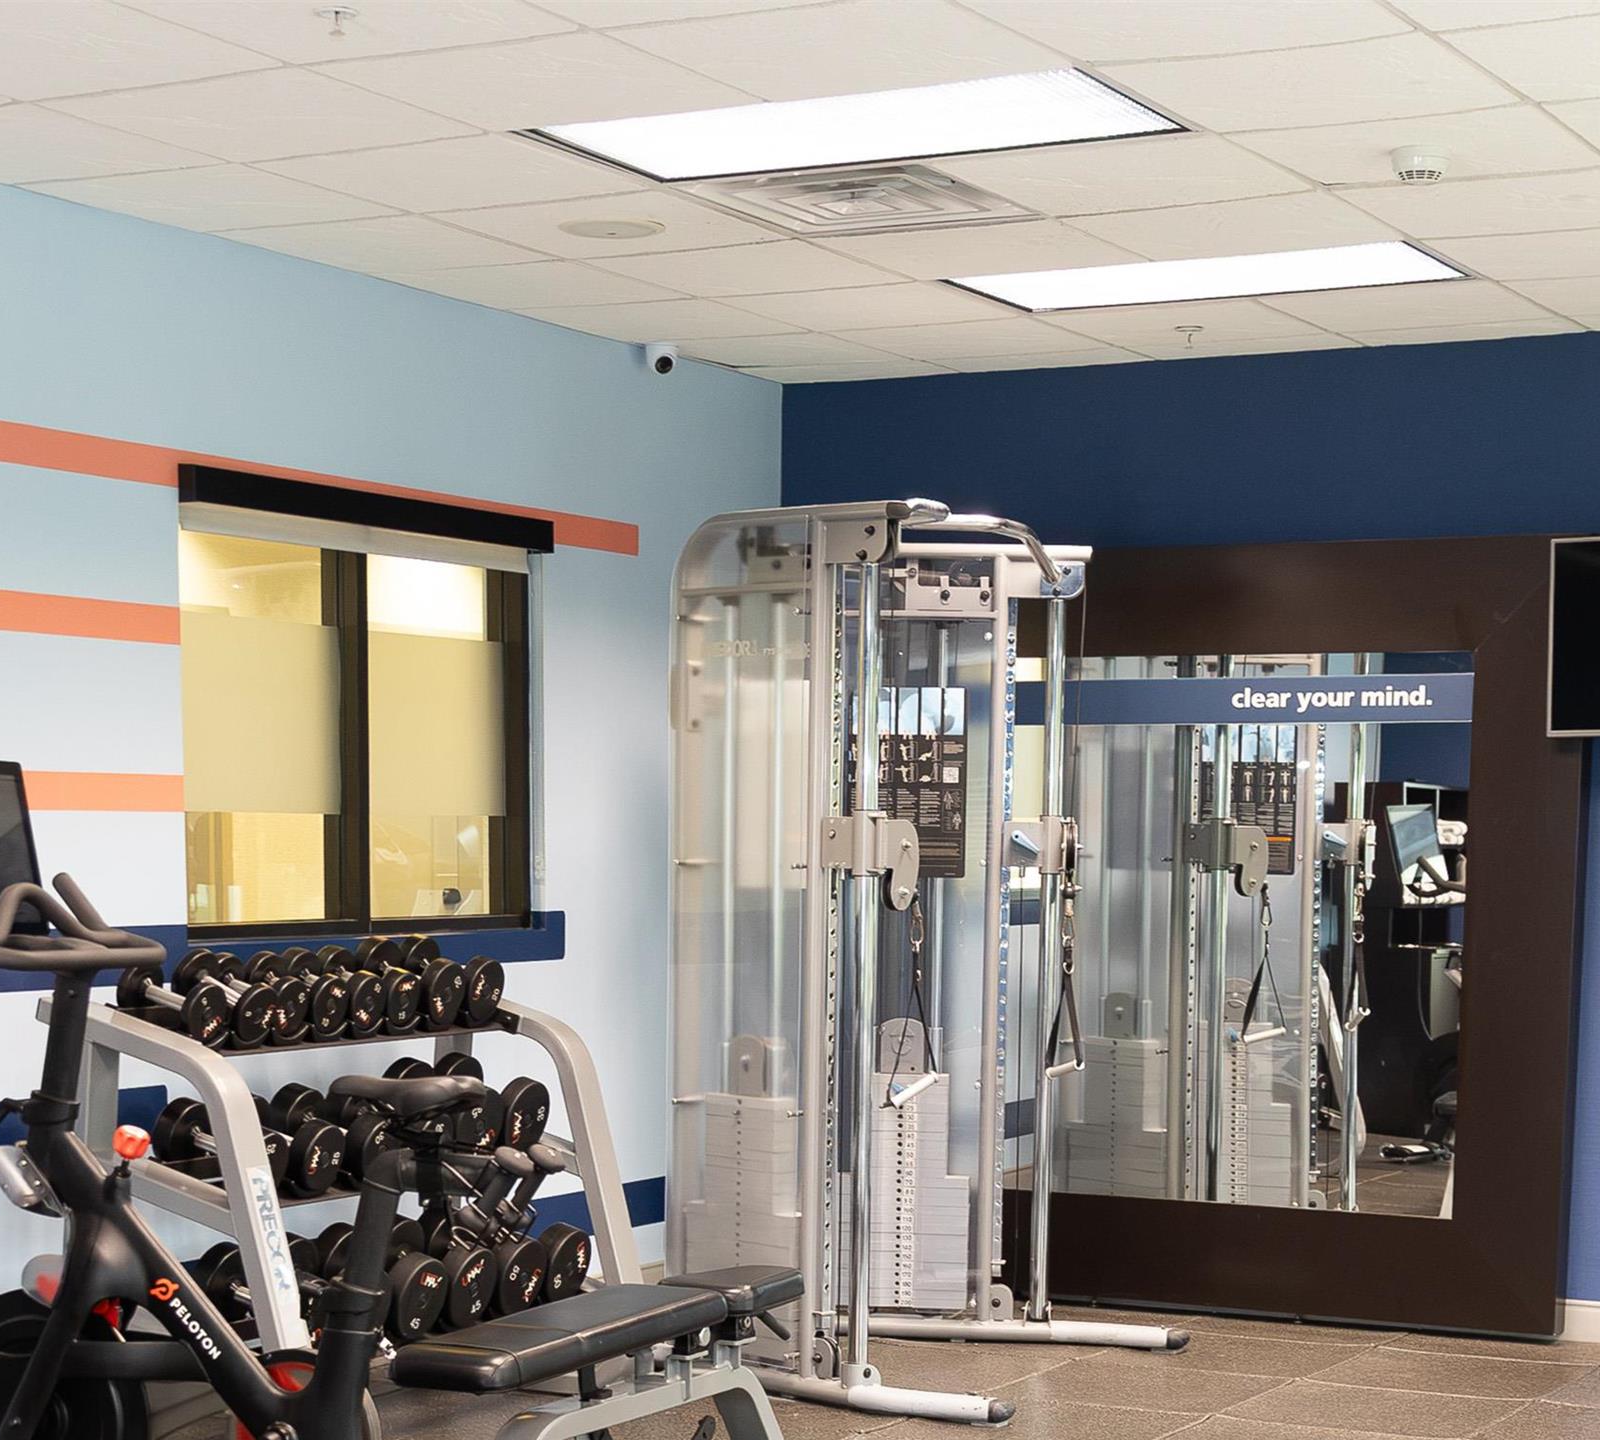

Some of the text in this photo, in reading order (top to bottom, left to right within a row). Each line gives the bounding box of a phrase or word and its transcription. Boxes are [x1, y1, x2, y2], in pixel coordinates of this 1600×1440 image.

[1231, 685, 1433, 713] clear your mind.
[169, 1297, 221, 1360] PELOTON
